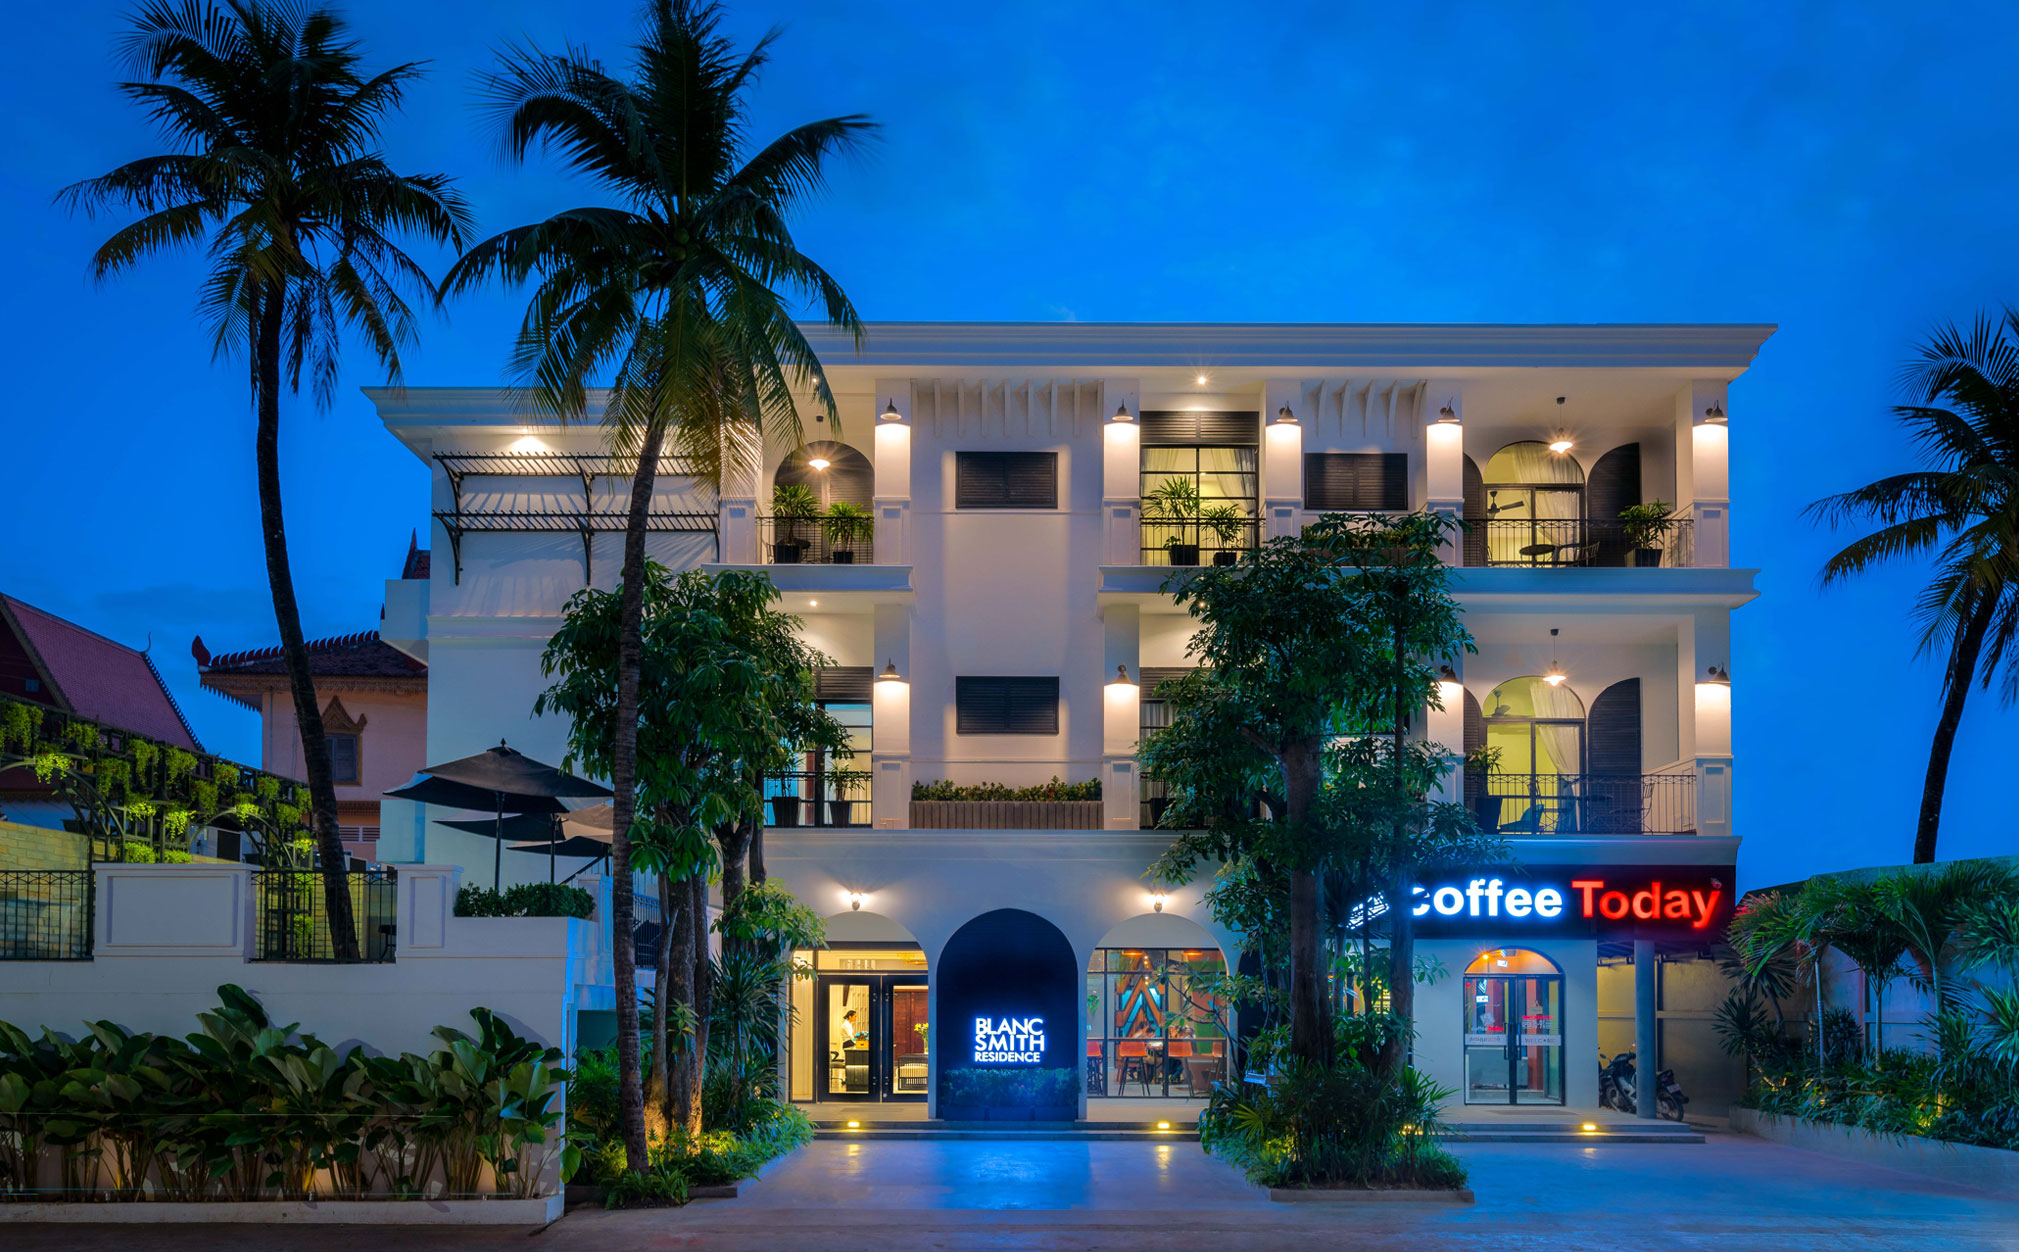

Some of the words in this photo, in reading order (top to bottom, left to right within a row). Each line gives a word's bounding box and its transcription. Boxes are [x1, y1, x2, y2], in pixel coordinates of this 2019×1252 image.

[1571, 880, 1721, 929] Today
[975, 1018, 1044, 1036] BLANC
[975, 1034, 1045, 1051] SMITH
[974, 1052, 1041, 1062] RESIDENCE
